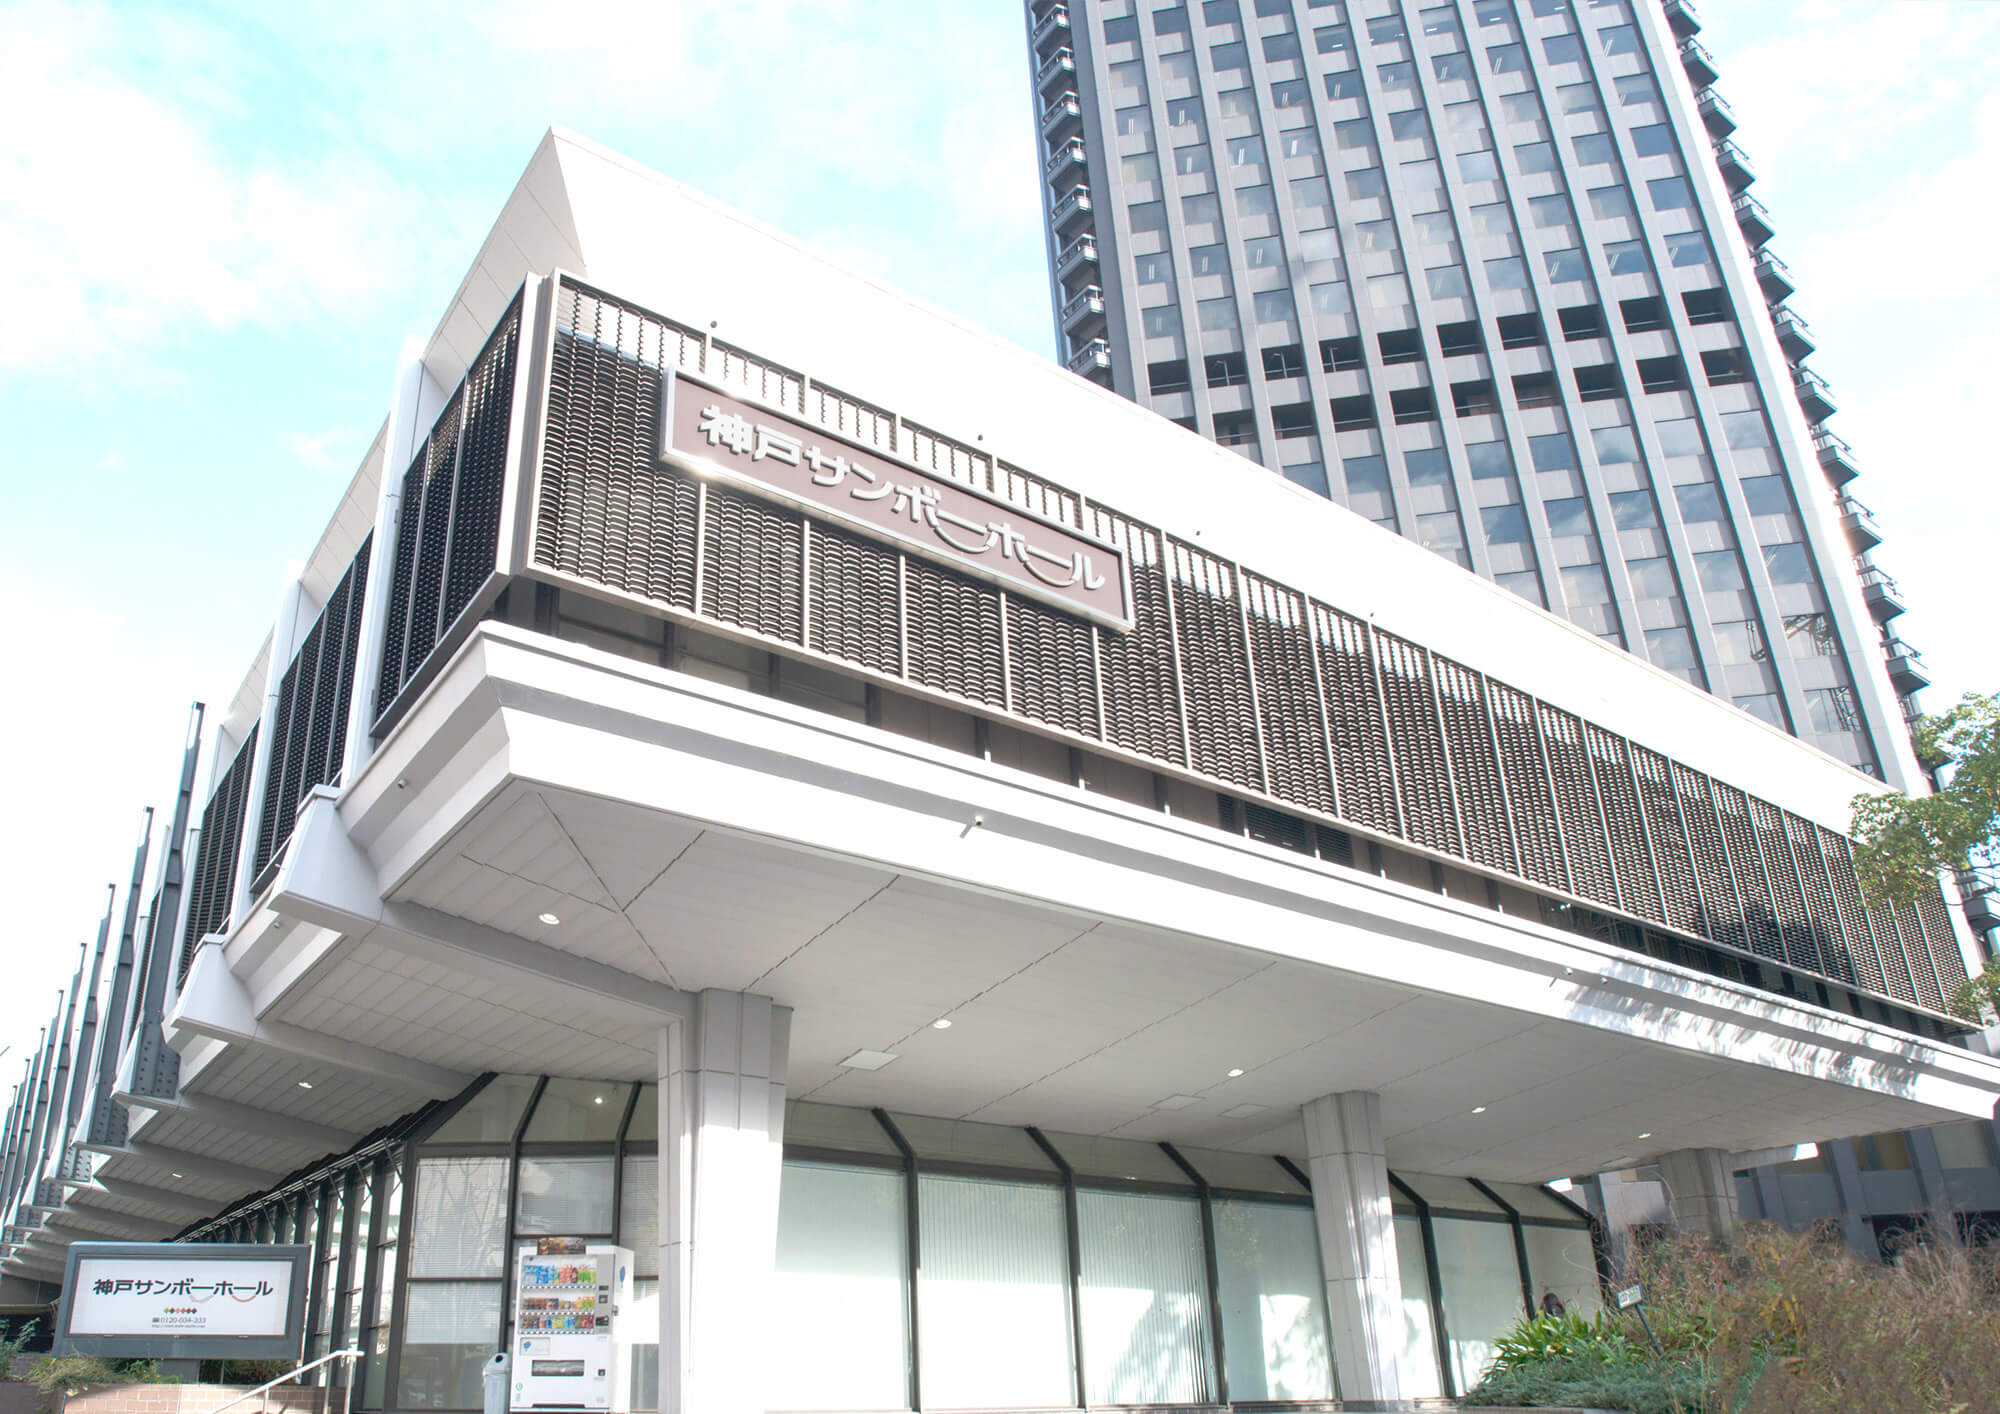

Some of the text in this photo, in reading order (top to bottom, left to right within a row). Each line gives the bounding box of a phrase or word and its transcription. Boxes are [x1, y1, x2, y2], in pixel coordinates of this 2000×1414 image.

[699, 403, 1105, 590] 神戸サンボーホール
[93, 1278, 274, 1301] 神戸サンボーホール
